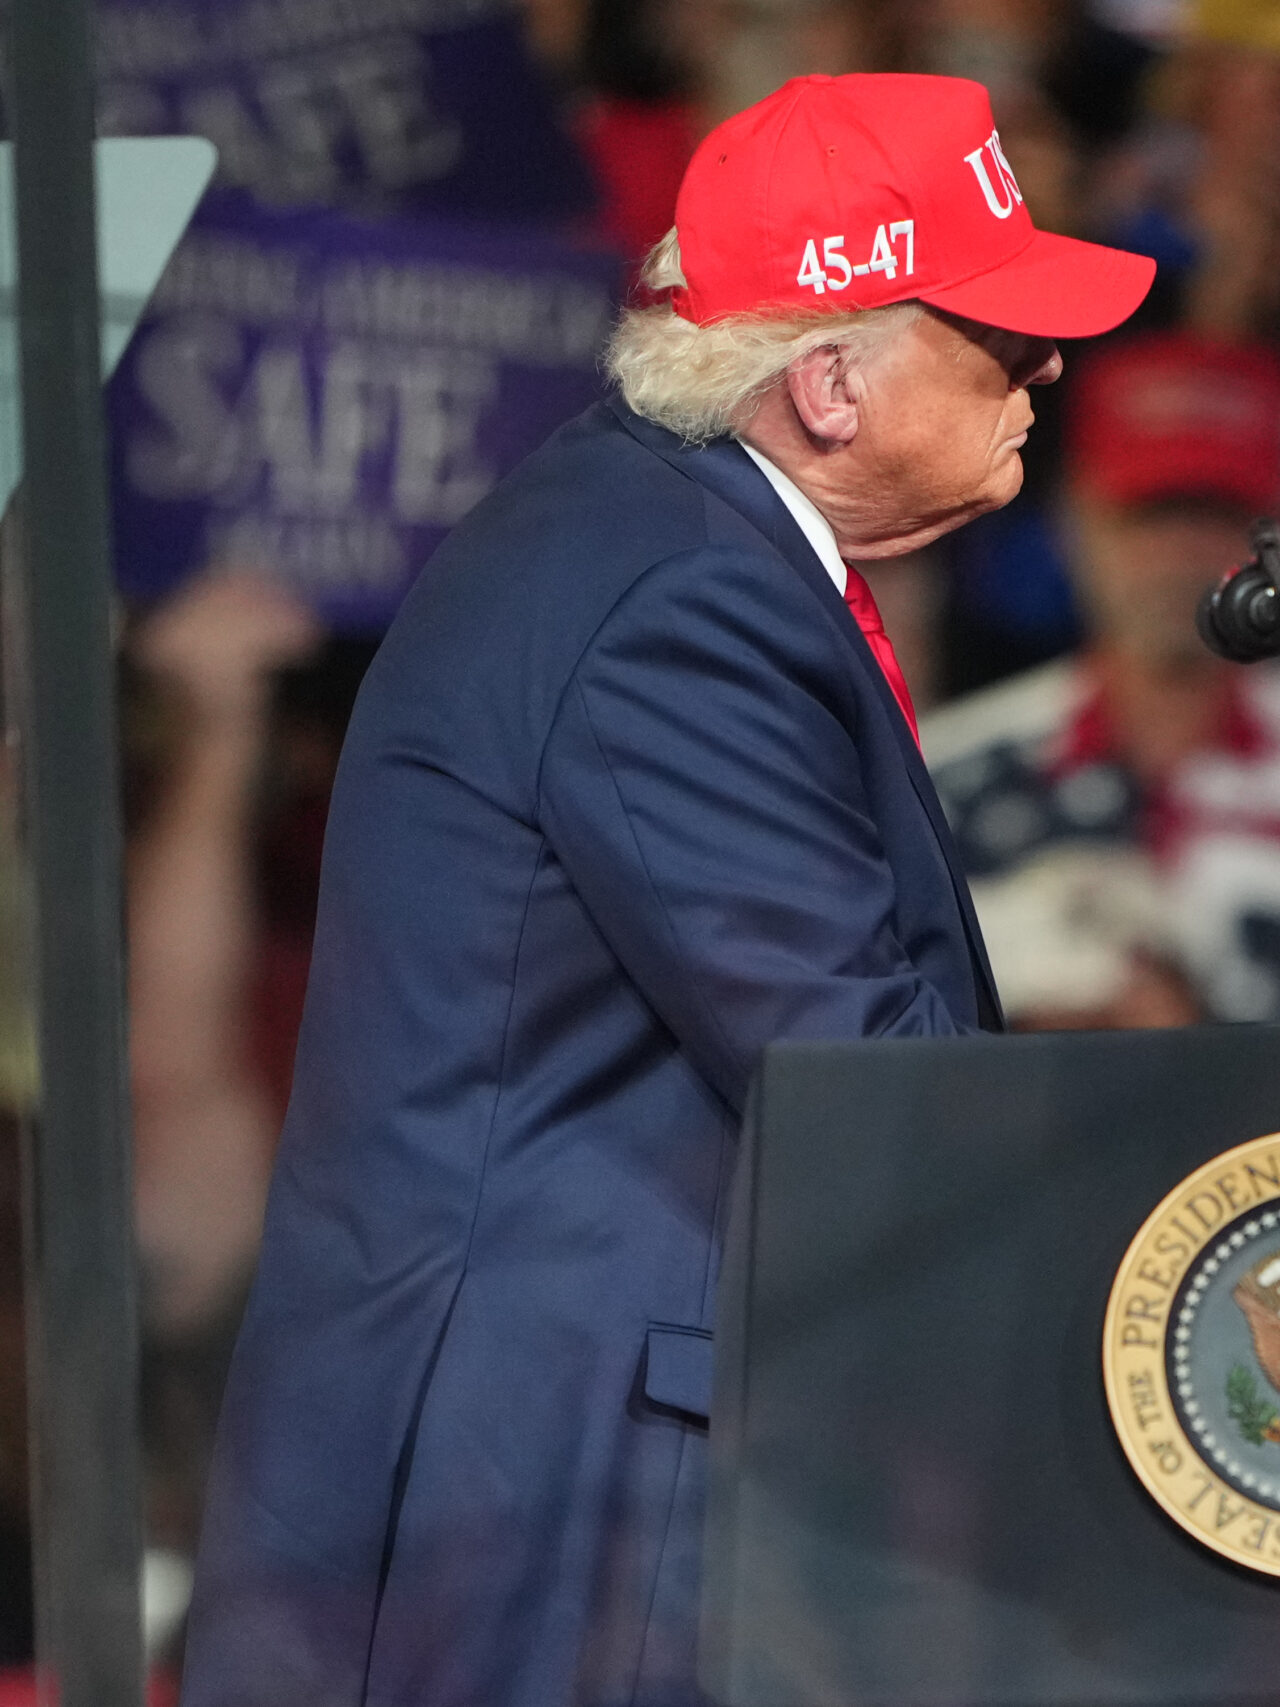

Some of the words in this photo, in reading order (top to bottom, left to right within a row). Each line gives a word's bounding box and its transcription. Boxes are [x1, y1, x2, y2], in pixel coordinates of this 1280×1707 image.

[963, 129, 1023, 219] US
[796, 219, 915, 294] 45-47
[124, 310, 500, 526] SAFE
[1128, 1369, 1163, 1429] THE
[1147, 1439, 1184, 1474] OF
